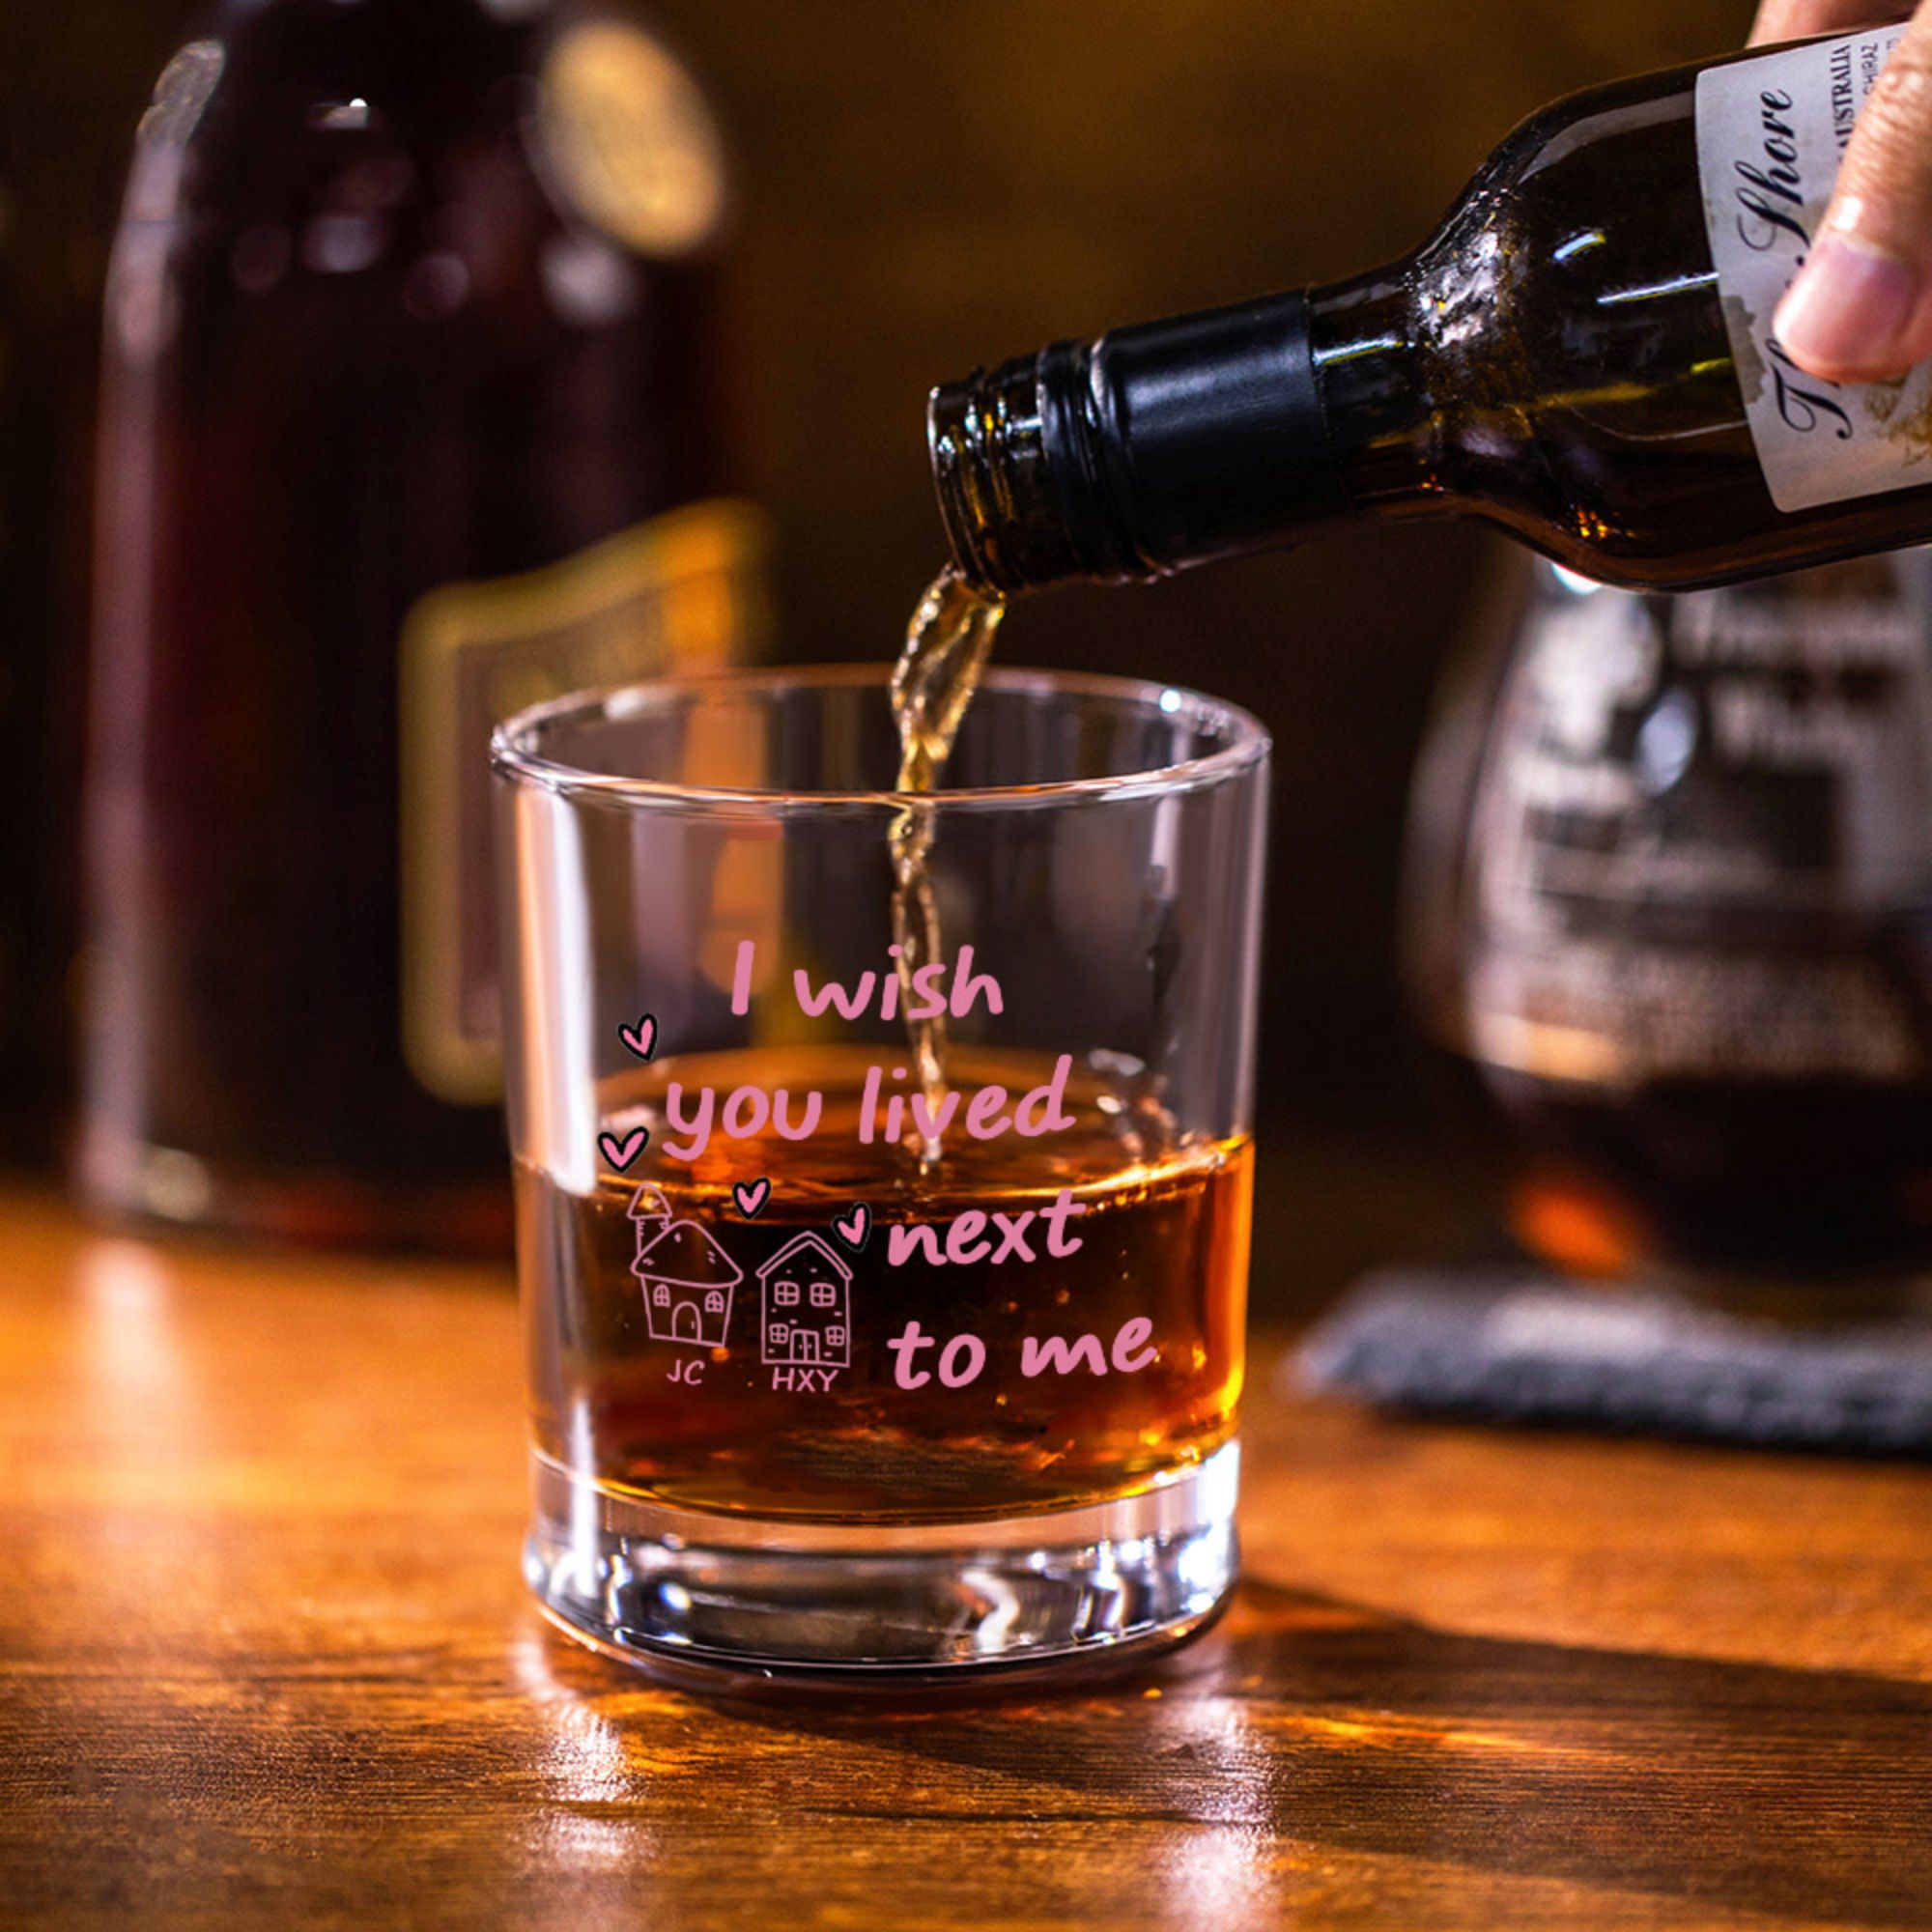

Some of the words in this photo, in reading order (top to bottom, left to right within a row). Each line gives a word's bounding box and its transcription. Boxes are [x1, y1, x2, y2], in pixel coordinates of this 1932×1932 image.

[1735, 88, 1811, 267] Shore
[731, 940, 754, 1015] I
[794, 945, 1004, 1021] wish
[662, 1081, 822, 1161] you
[859, 1054, 1076, 1144] lived
[887, 1189, 1087, 1266] next
[667, 1359, 705, 1385] JC
[772, 1366, 839, 1393] HXY
[887, 1321, 986, 1389] to
[1020, 1317, 1158, 1377] me
